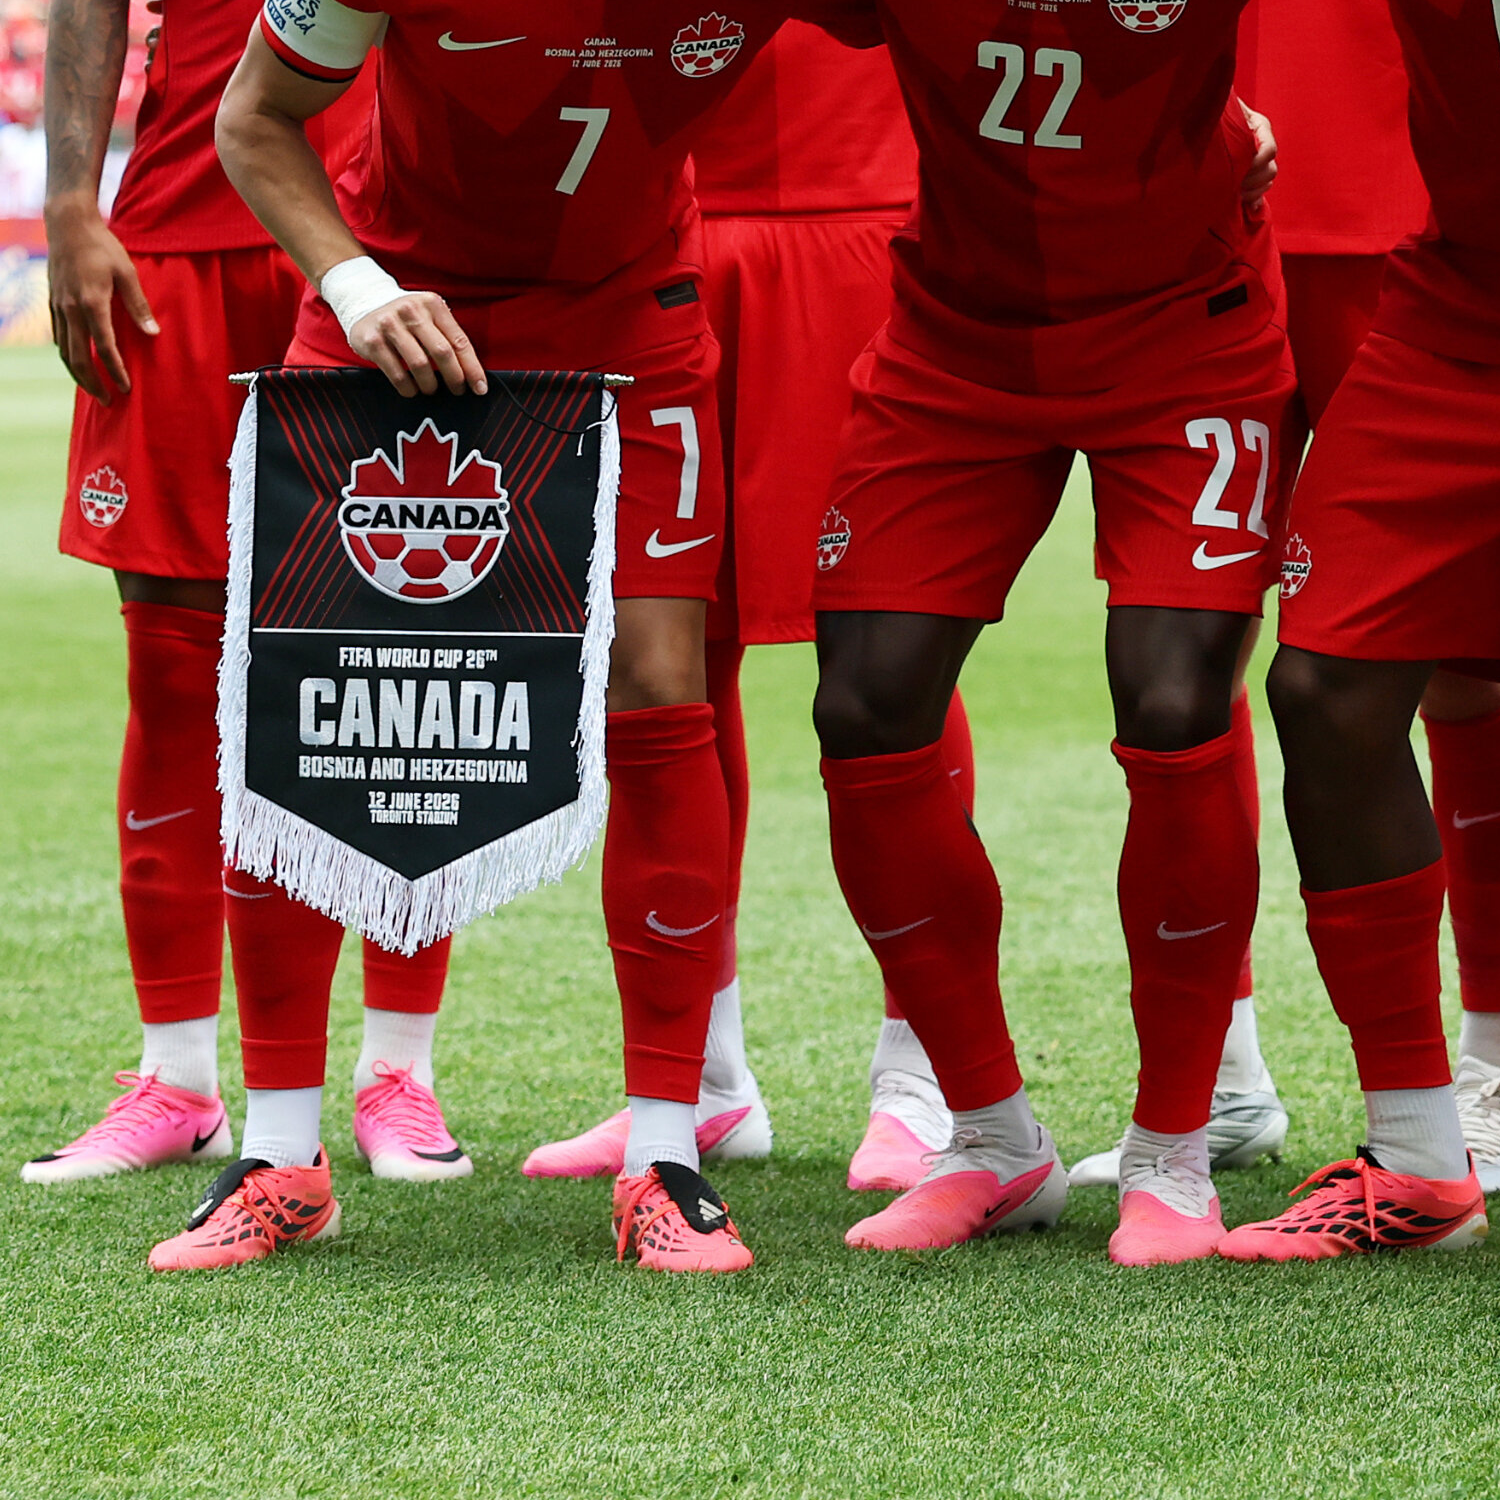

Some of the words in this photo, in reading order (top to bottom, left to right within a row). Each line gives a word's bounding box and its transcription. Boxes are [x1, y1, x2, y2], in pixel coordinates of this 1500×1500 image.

[1007, 0, 1014, 7] 12
[1018, 0, 1036, 10] JUNE
[1040, 3, 1058, 12] 2026
[584, 38, 616, 46] CANADA
[672, 37, 741, 55] CANADA
[545, 49, 576, 57] BOSNIA
[579, 49, 596, 57] AND
[599, 49, 654, 58] HERZEGOVINA
[572, 60, 579, 68] 12
[583, 60, 601, 68] JUNE
[977, 41, 1082, 149] 22
[555, 107, 610, 195] 7
[650, 406, 700, 519] 7
[1185, 417, 1270, 540] 22
[81, 490, 123, 505] CANADA
[343, 503, 504, 530] CANADA
[339, 646, 373, 667] FIFA
[376, 647, 431, 668] WORLD
[434, 648, 463, 669] CUP
[299, 677, 531, 751] CANADA
[299, 755, 366, 780] BOSNIA
[370, 756, 405, 781] AND
[409, 758, 528, 783] HERZEGOVINA
[368, 791, 386, 809] 12
[388, 791, 421, 810] JUNE
[423, 792, 460, 811] 2026
[370, 809, 414, 824] TORONTO
[416, 810, 458, 825] STADIUM
